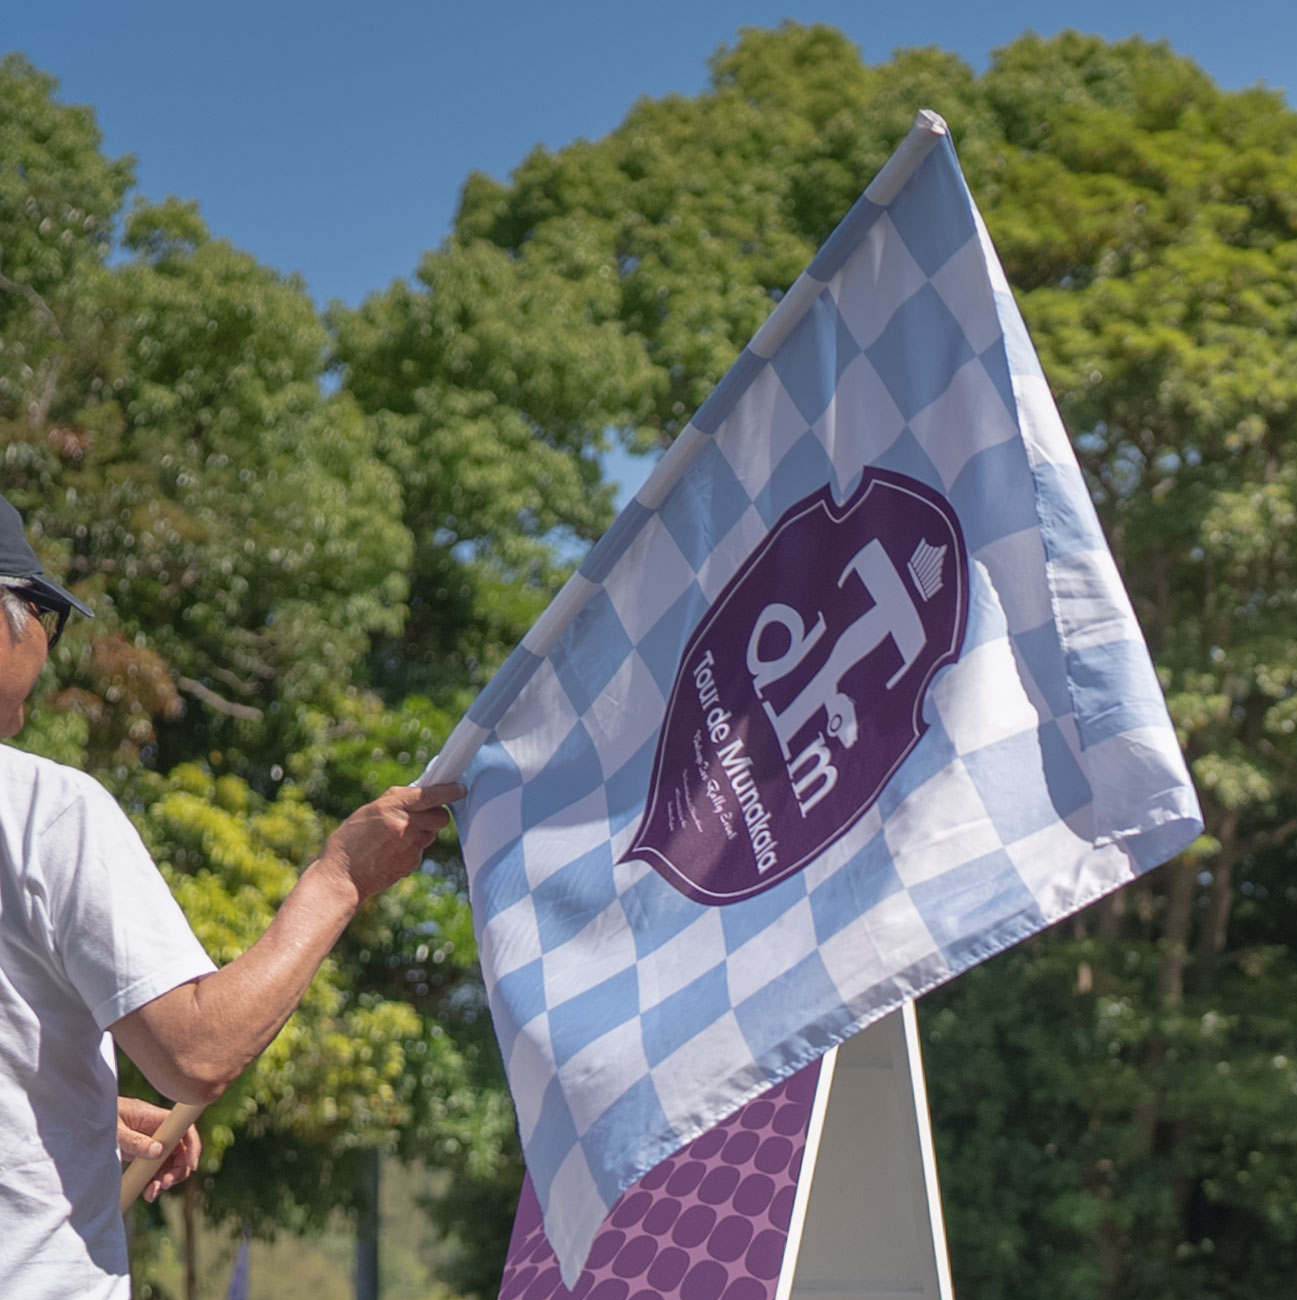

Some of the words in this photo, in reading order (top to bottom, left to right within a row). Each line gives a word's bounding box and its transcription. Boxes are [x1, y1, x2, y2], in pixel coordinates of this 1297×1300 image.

[693, 649, 720, 711] Tour
[706, 706, 732, 743] de
[706, 779, 726, 814] Rally
[716, 736, 778, 875] Munakata
